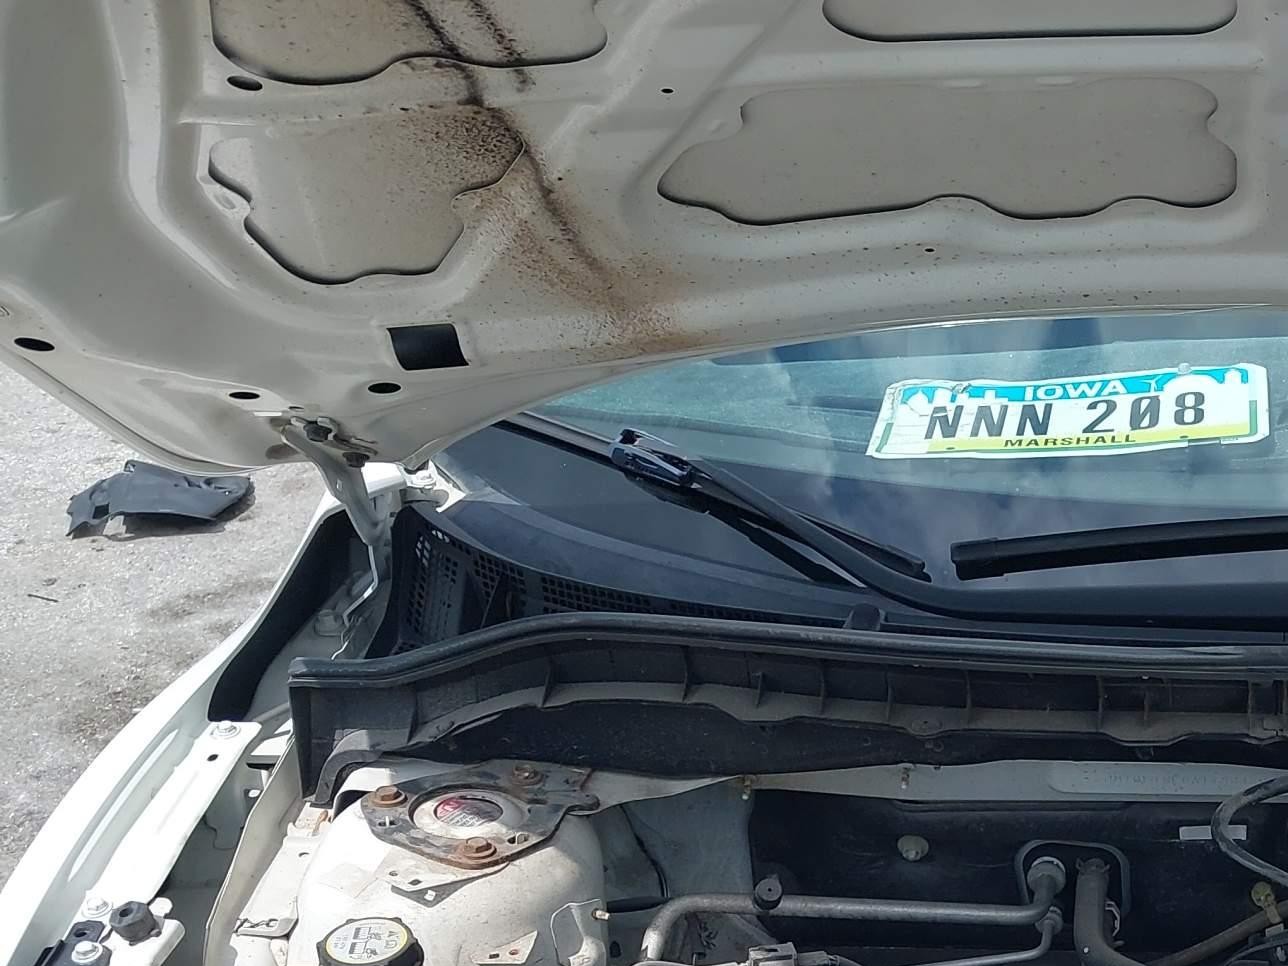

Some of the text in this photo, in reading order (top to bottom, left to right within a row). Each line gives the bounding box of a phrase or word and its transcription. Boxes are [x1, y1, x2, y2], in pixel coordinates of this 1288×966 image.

[1024, 379, 1128, 400] IOWA
[924, 391, 1206, 440] NNN 208
[1003, 434, 1137, 448] MARSHALL
